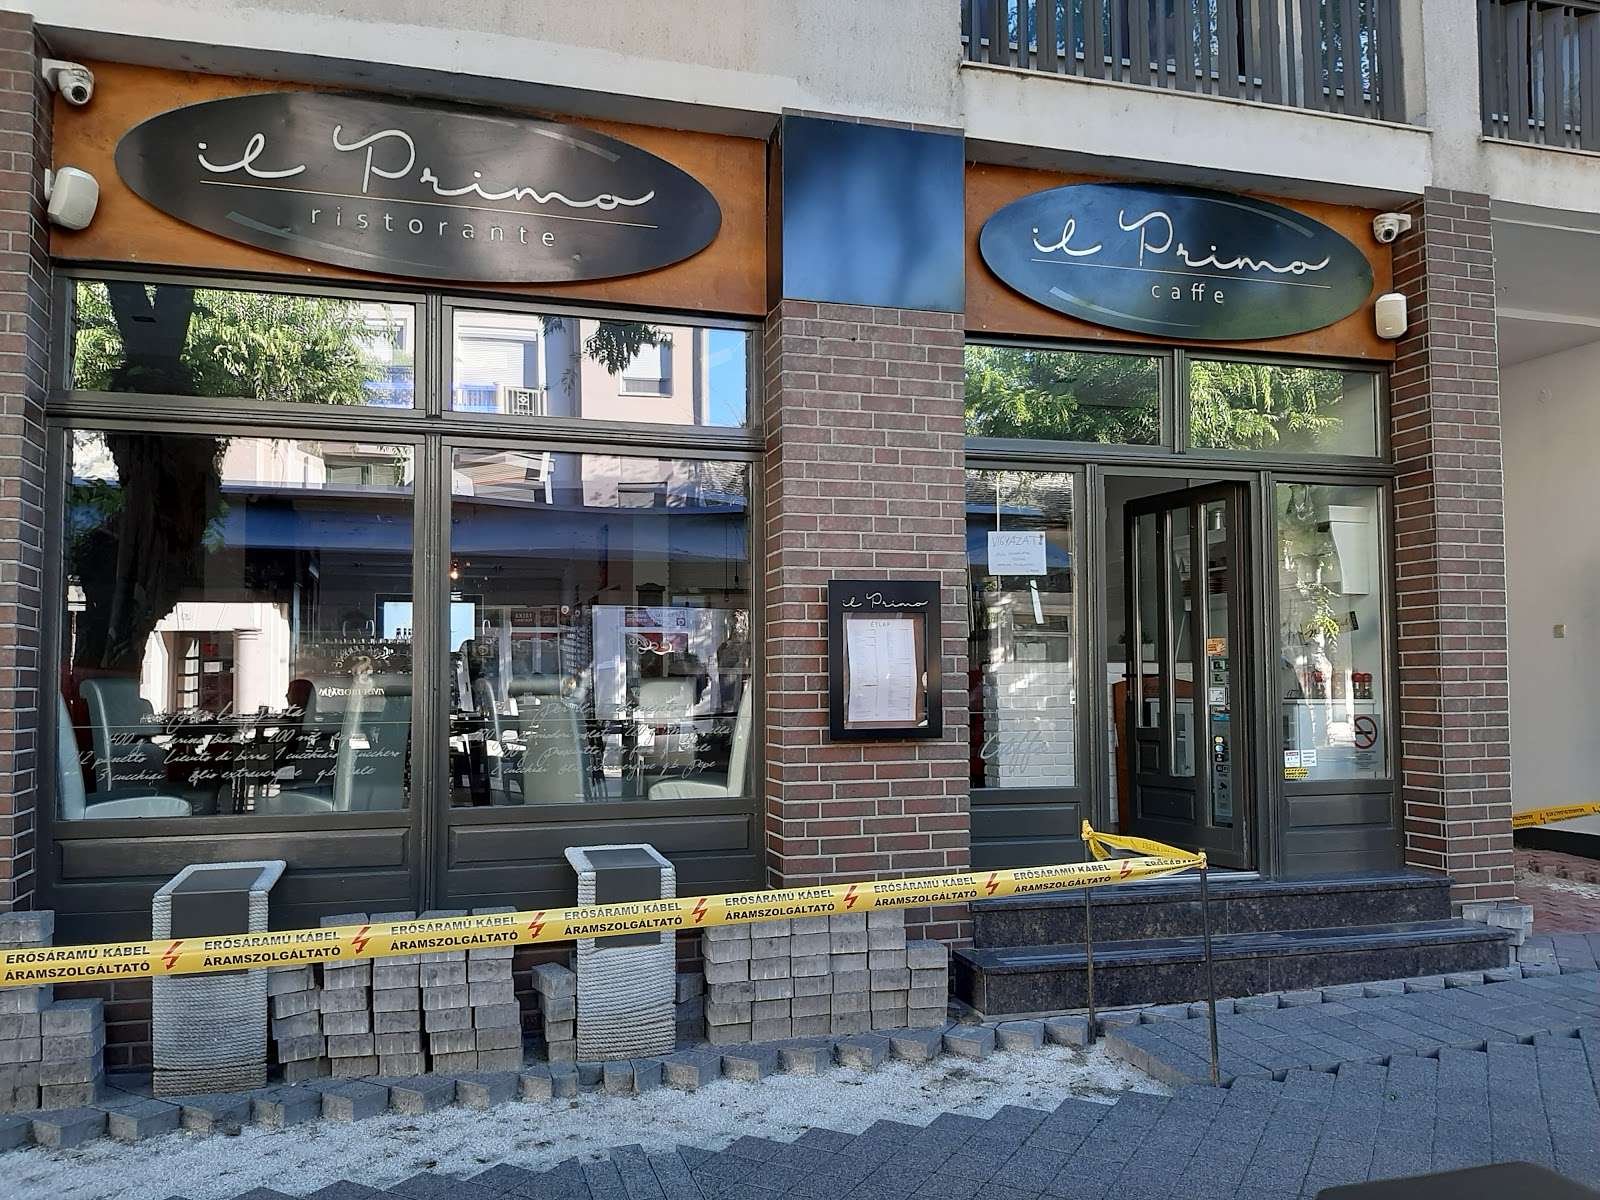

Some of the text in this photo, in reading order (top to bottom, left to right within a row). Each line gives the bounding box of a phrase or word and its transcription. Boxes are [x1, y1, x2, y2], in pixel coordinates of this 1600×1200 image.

[332, 123, 656, 211] Primo
[310, 205, 557, 248] ristorante
[1119, 209, 1331, 275] Primo
[1151, 283, 1225, 304] caffe
[865, 592, 929, 609] Primo
[942, 876, 977, 888] KÁBEL
[1014, 875, 1112, 893] ÁRAMSZOLGÁLTATÓ
[798, 889, 835, 900] KÁBEL
[874, 889, 978, 907] ÁRAMSZOLGÁLTATÓ
[643, 902, 682, 914] KÁBEL
[725, 902, 836, 921] ÁRAMSZOLGÁLTATÓ
[476, 916, 518, 928] KÁBEL
[564, 915, 683, 935] ÁRAMSZOLGÁLTATÓ
[296, 931, 341, 943] KÁBEL
[391, 930, 519, 951] ÁRAMSZOLGÁLTATÓ
[103, 946, 151, 958] KÁBEL
[203, 945, 342, 967] ÁRAMSZOLGÁLTATÓ
[5, 961, 151, 981] ÁRAMSZOLGÁLTATÓ
